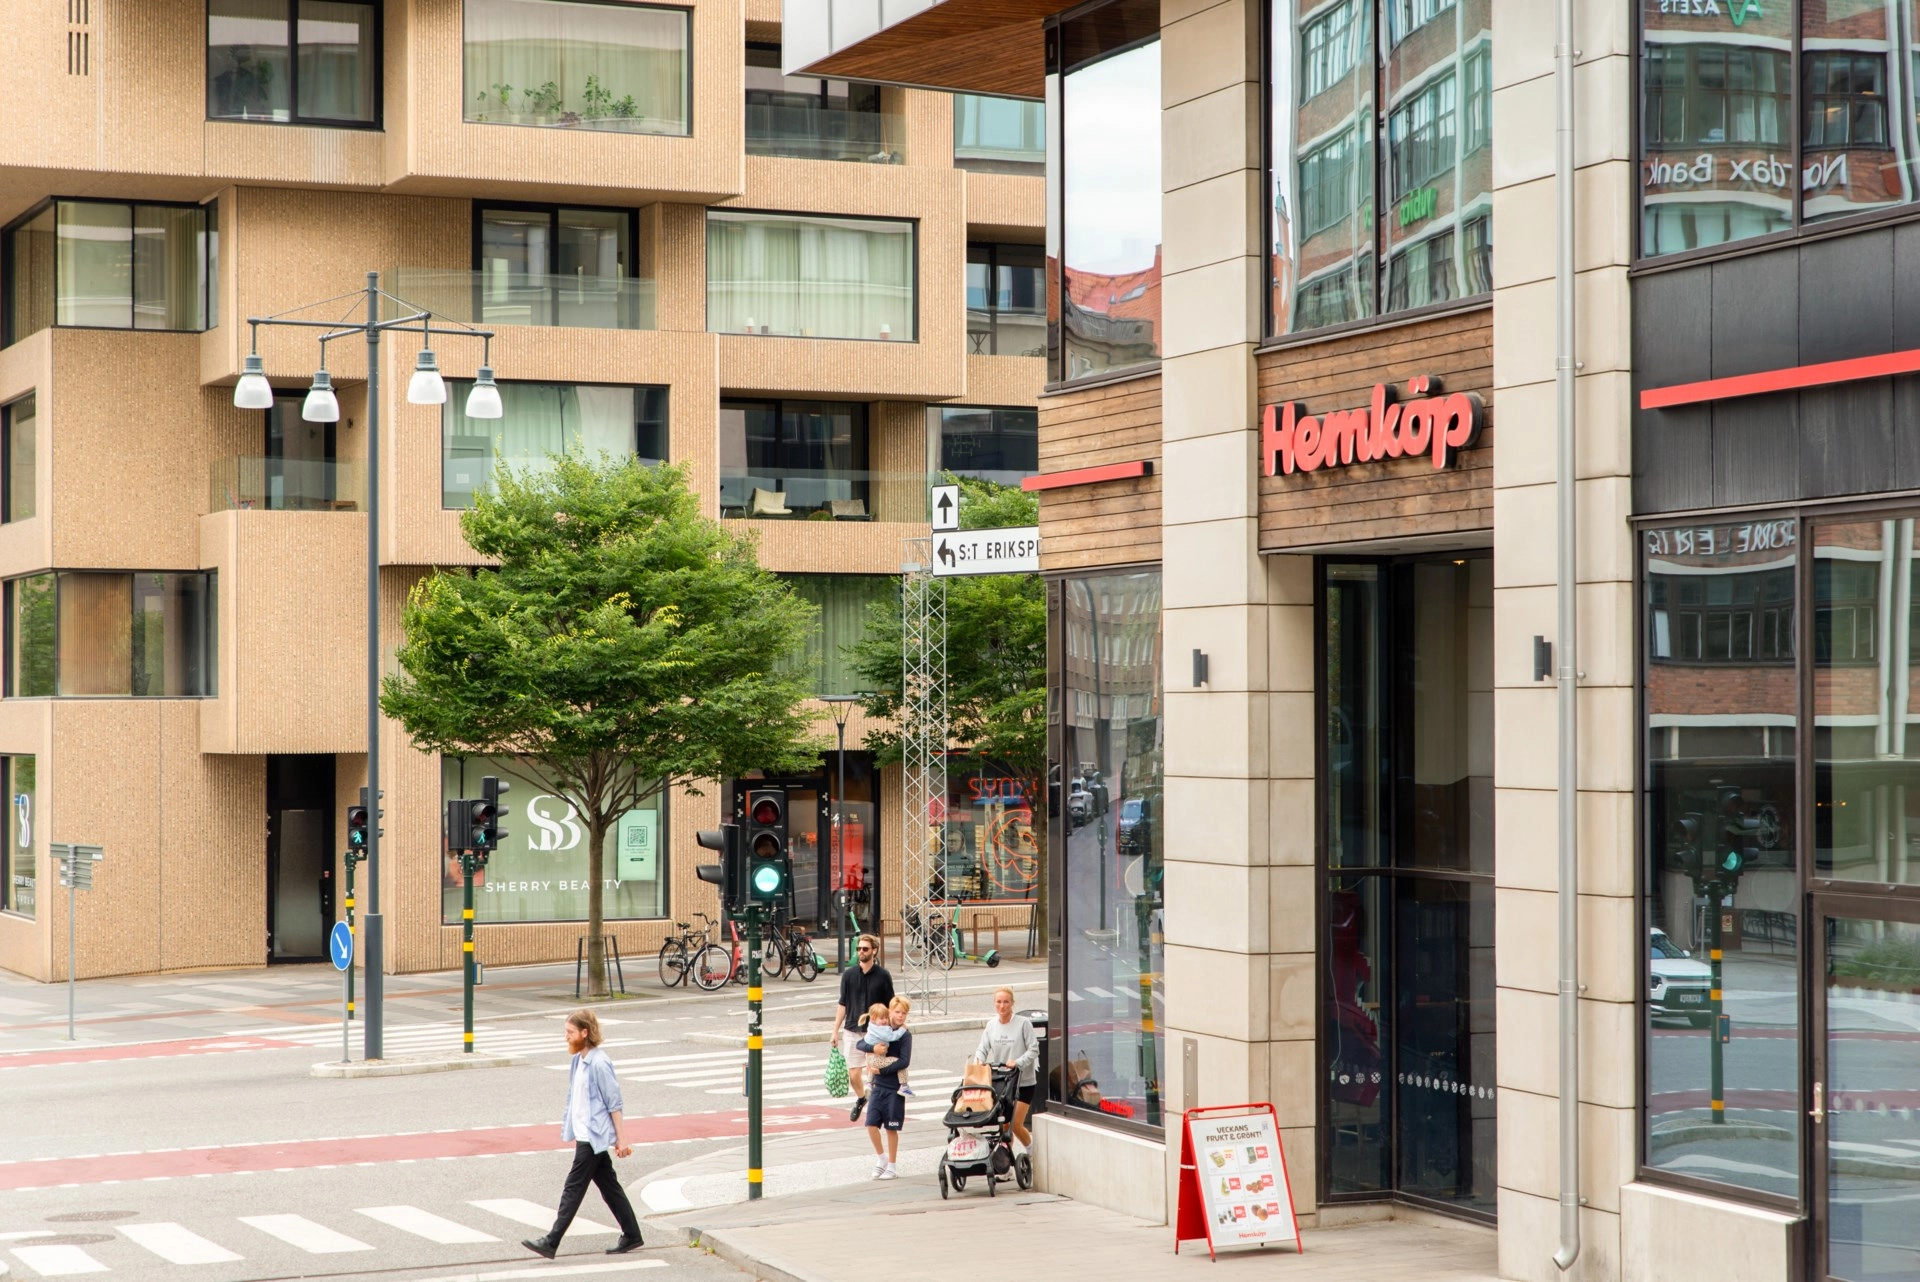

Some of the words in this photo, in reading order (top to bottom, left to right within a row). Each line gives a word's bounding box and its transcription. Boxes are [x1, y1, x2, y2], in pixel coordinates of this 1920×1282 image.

[1263, 374, 1476, 477] Hemköp
[959, 543, 978, 561] S:T
[485, 881, 551, 893] SHERRY
[559, 879, 622, 891] BEATY
[1216, 1124, 1249, 1134] VECKANS
[1206, 1134, 1229, 1142] FRUKT
[1237, 1131, 1262, 1140] GRÖNT!
